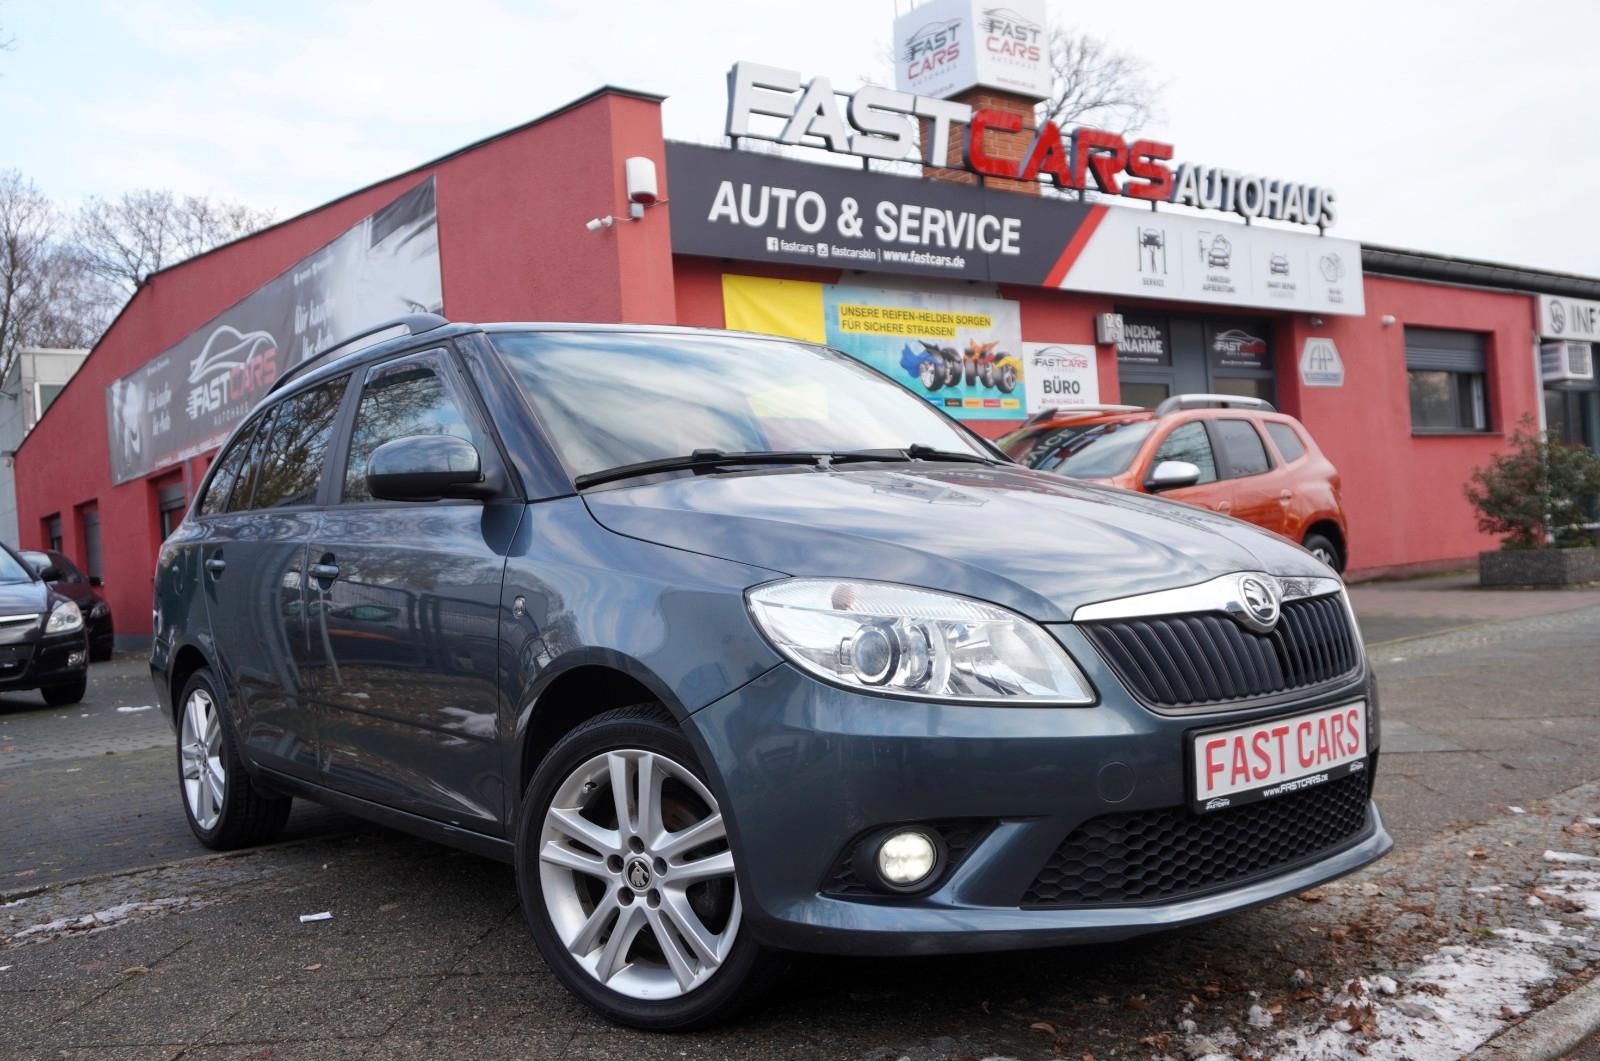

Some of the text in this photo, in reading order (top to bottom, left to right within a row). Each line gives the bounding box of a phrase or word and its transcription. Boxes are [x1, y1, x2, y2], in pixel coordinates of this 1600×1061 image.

[909, 22, 961, 62] FAST
[990, 19, 1041, 44] FAST
[907, 42, 960, 80] CARS
[985, 36, 1041, 62] CARS
[1173, 161, 1337, 229] AUTOHAUS
[707, 180, 1023, 256] AUTO & SERVICE
[780, 239, 965, 269] fastcars fastcarsbln www.fastcars.de
[840, 305, 992, 327] UNSERE REIFEN-HELDEN SORGEN
[841, 319, 956, 337] FÜR SICHERE STRASSEN!
[1570, 304, 1600, 335] INF
[1123, 324, 1161, 339] NDEN-
[1042, 375, 1081, 395] BÜRO
[1205, 708, 1360, 792] FAST CARS
